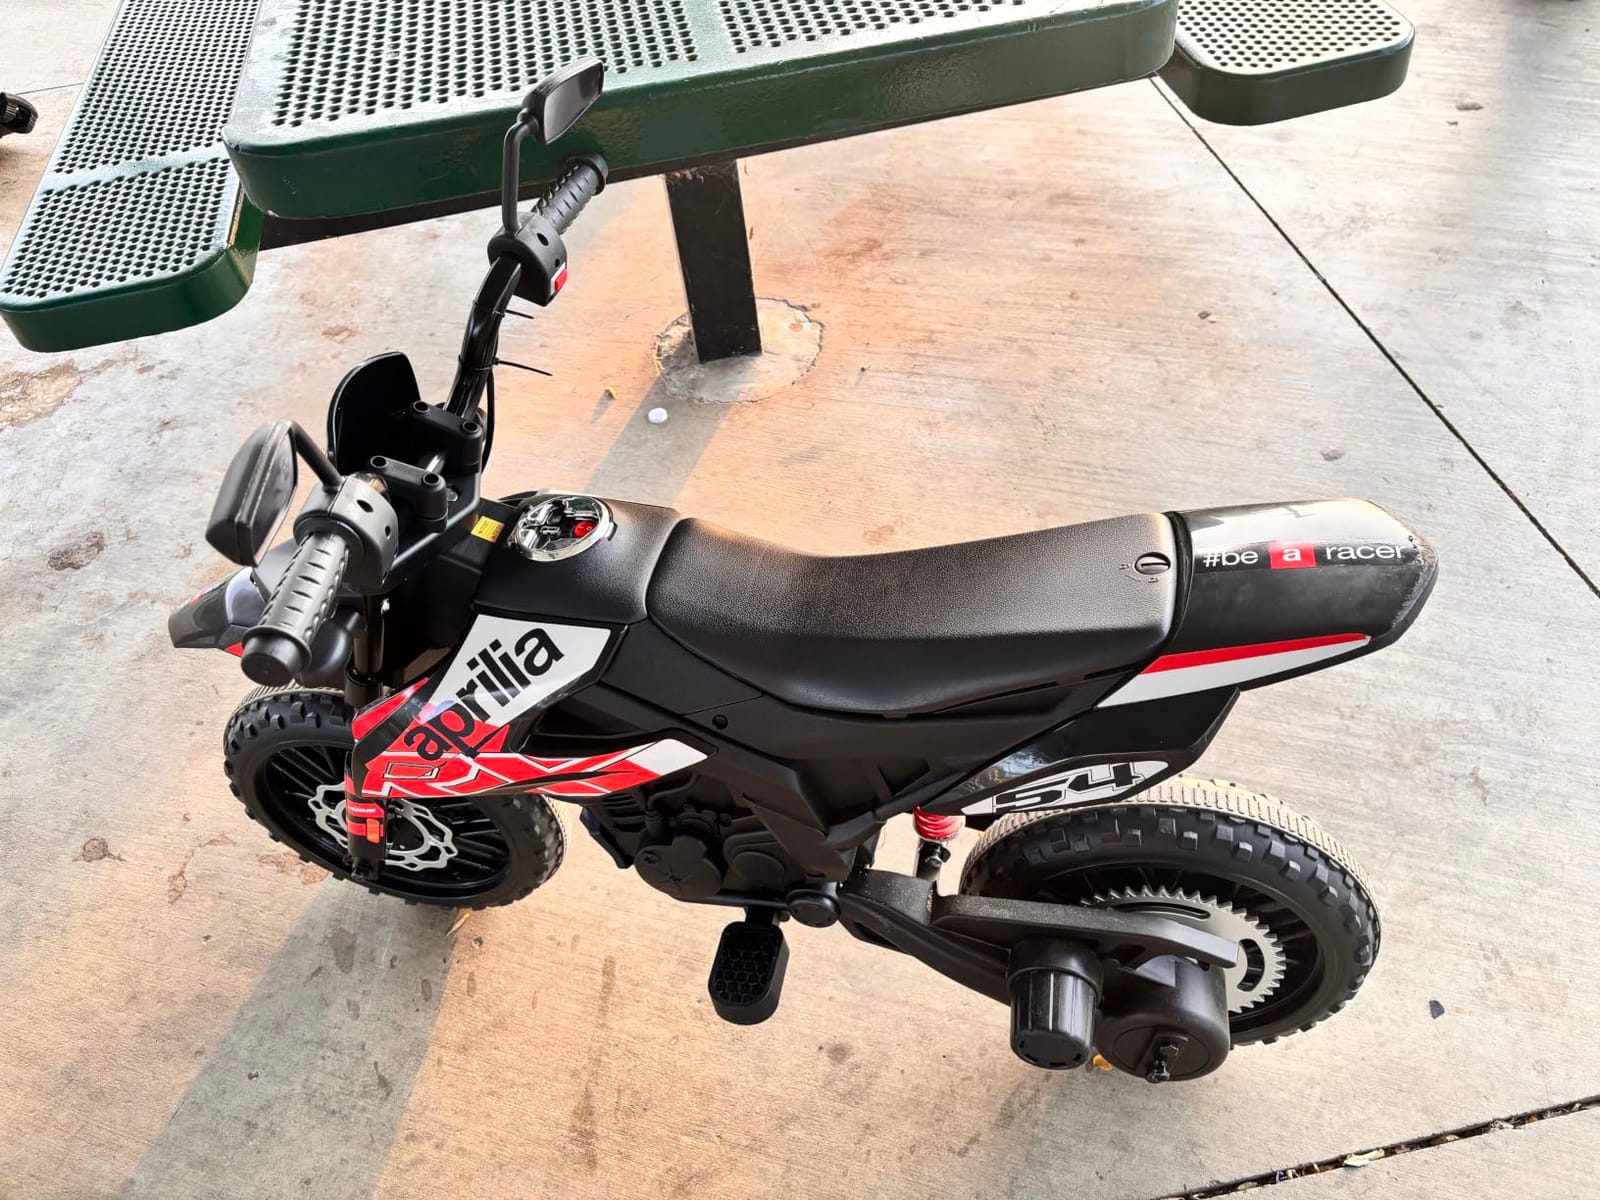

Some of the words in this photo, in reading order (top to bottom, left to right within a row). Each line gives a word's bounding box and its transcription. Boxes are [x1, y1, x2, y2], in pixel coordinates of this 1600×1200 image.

[1203, 549, 1259, 567] #be
[1282, 548, 1302, 562] a
[1326, 543, 1403, 560] racer
[404, 628, 565, 761] aprilia
